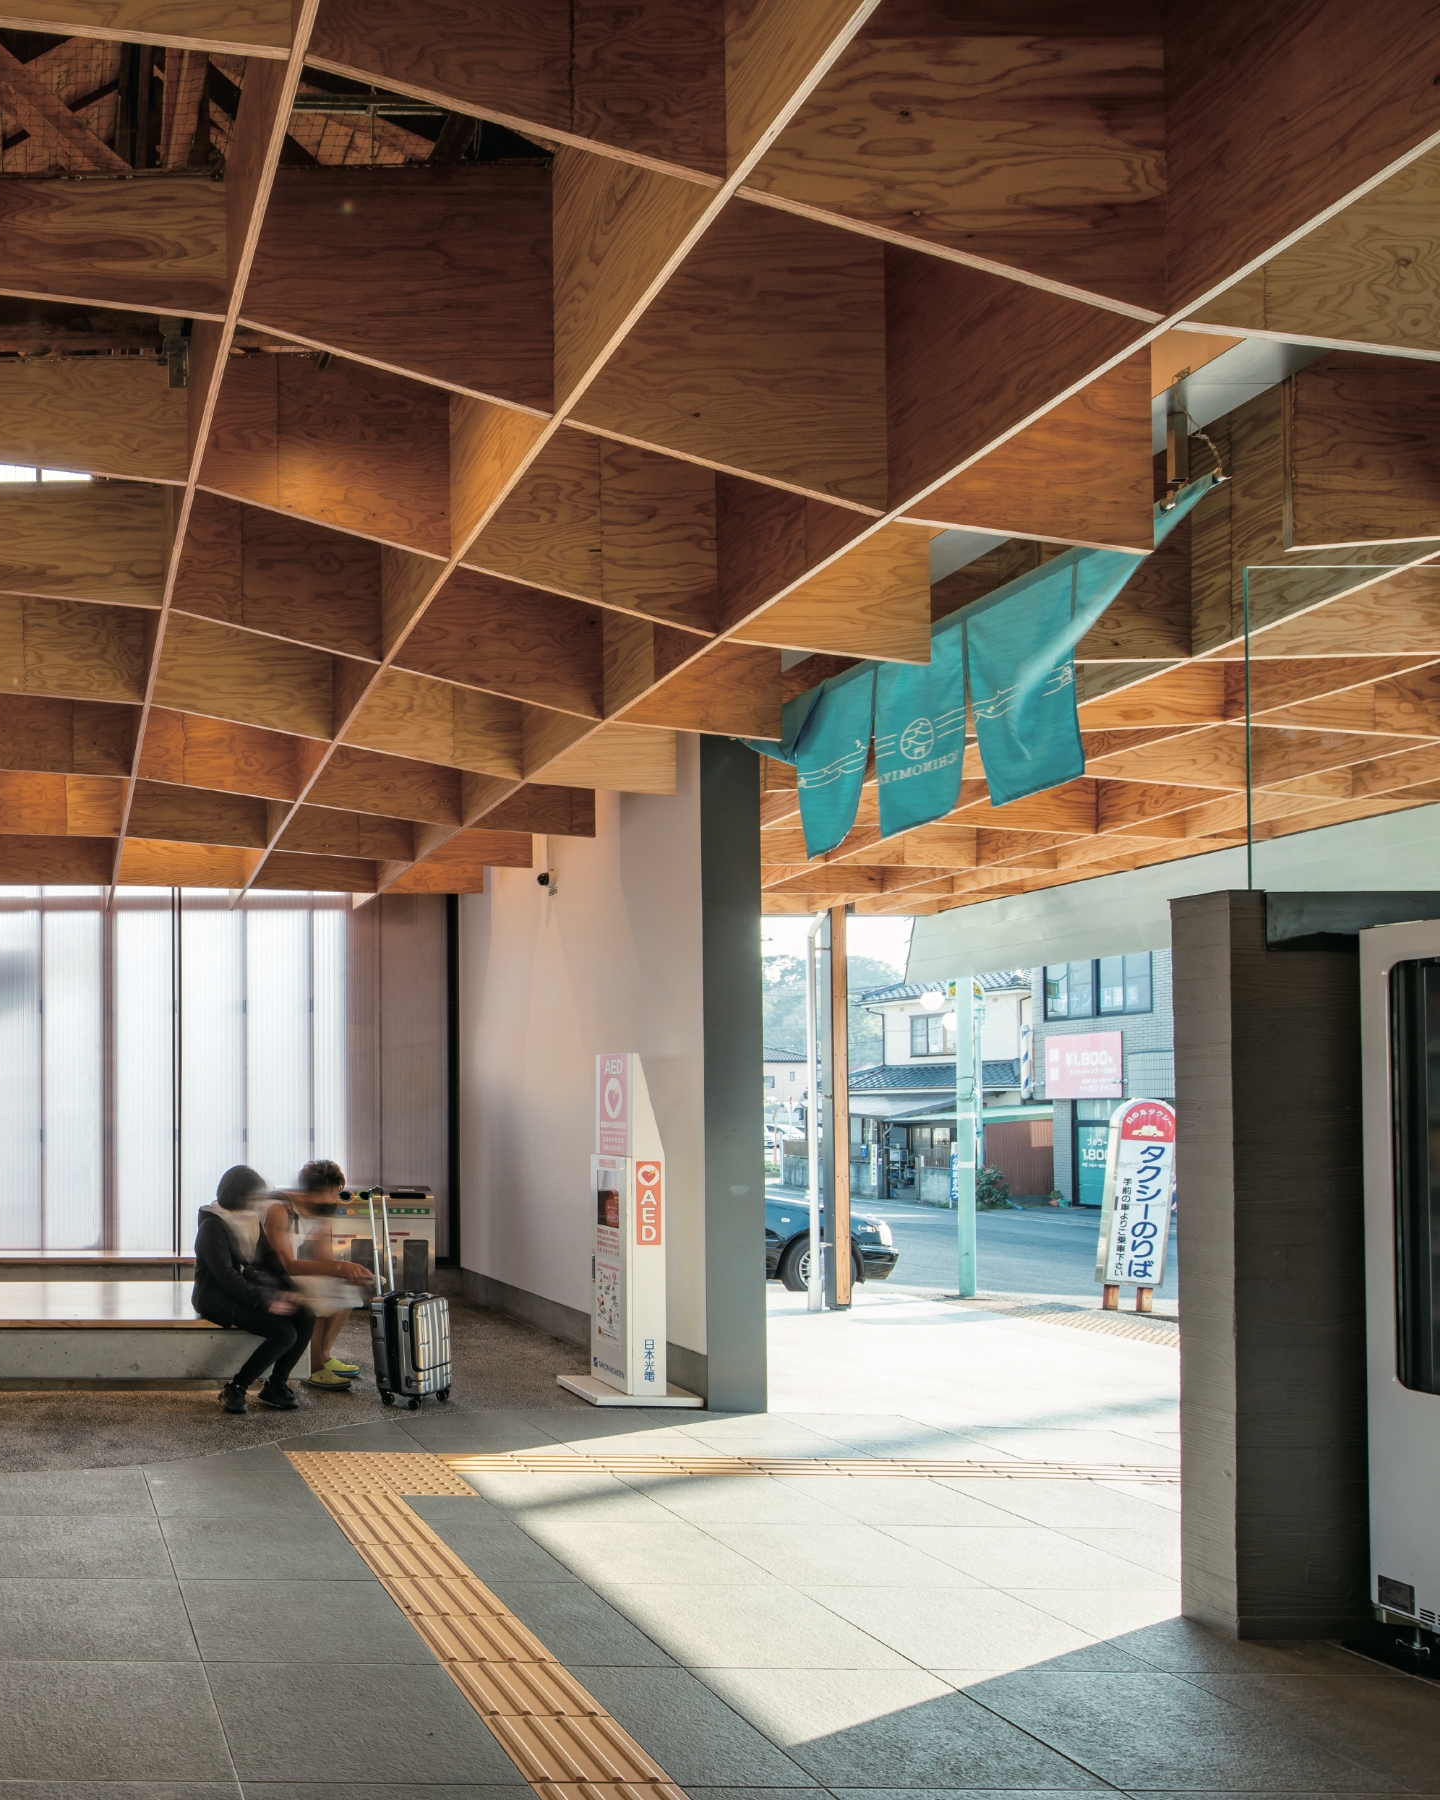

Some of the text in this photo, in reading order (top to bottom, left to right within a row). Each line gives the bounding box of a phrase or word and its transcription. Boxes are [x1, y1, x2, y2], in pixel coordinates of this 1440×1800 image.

[604, 1059, 624, 1076] AED
[1125, 1108, 1173, 1127] 日の丸タクシー
[640, 1189, 658, 1243] AED
[1113, 1177, 1133, 1277] 手前の車よりご乗車下さい
[1127, 1145, 1166, 1279] タクシーのりば
[643, 1339, 656, 1383] 日本光電
